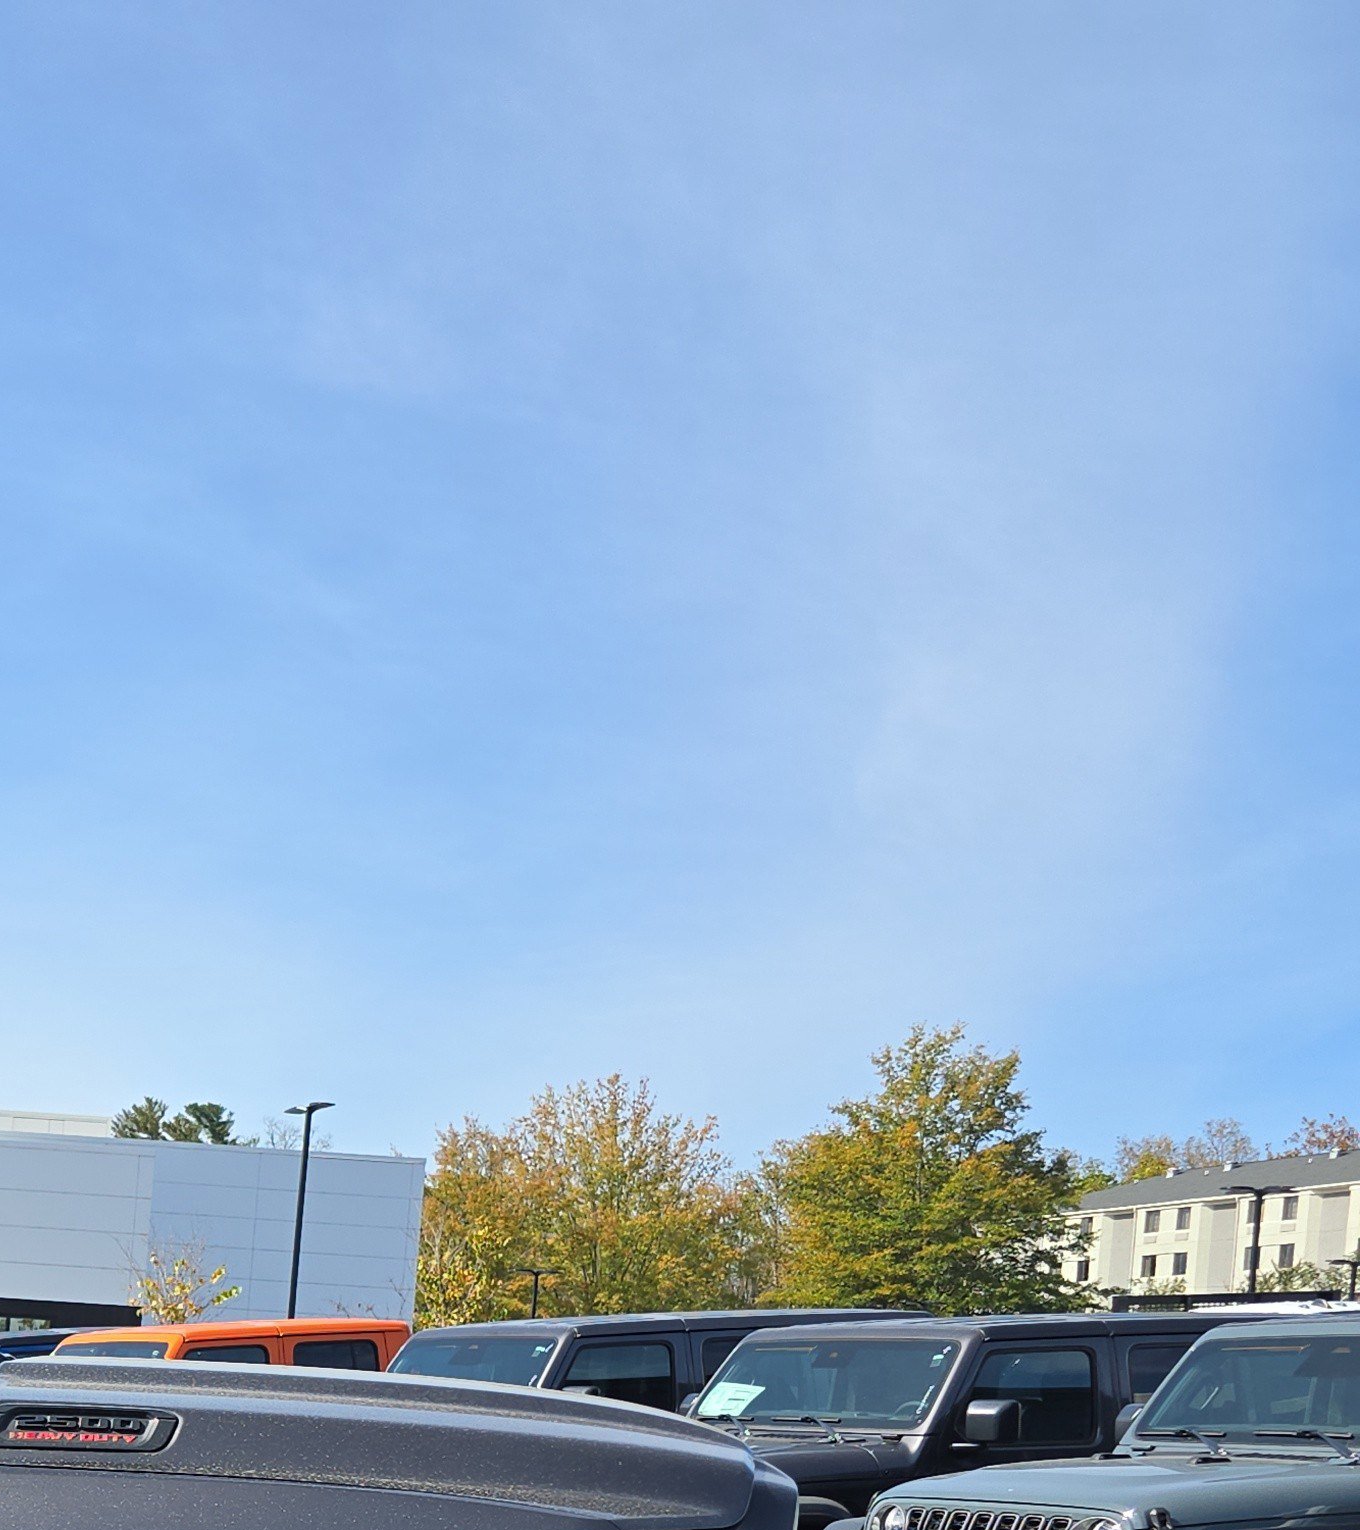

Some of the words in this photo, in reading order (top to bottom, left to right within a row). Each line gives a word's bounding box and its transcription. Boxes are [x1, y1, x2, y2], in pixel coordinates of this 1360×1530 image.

[14, 1415, 147, 1435] 2500
[8, 1431, 77, 1442] HEAVY
[79, 1433, 138, 1444] DUTY
